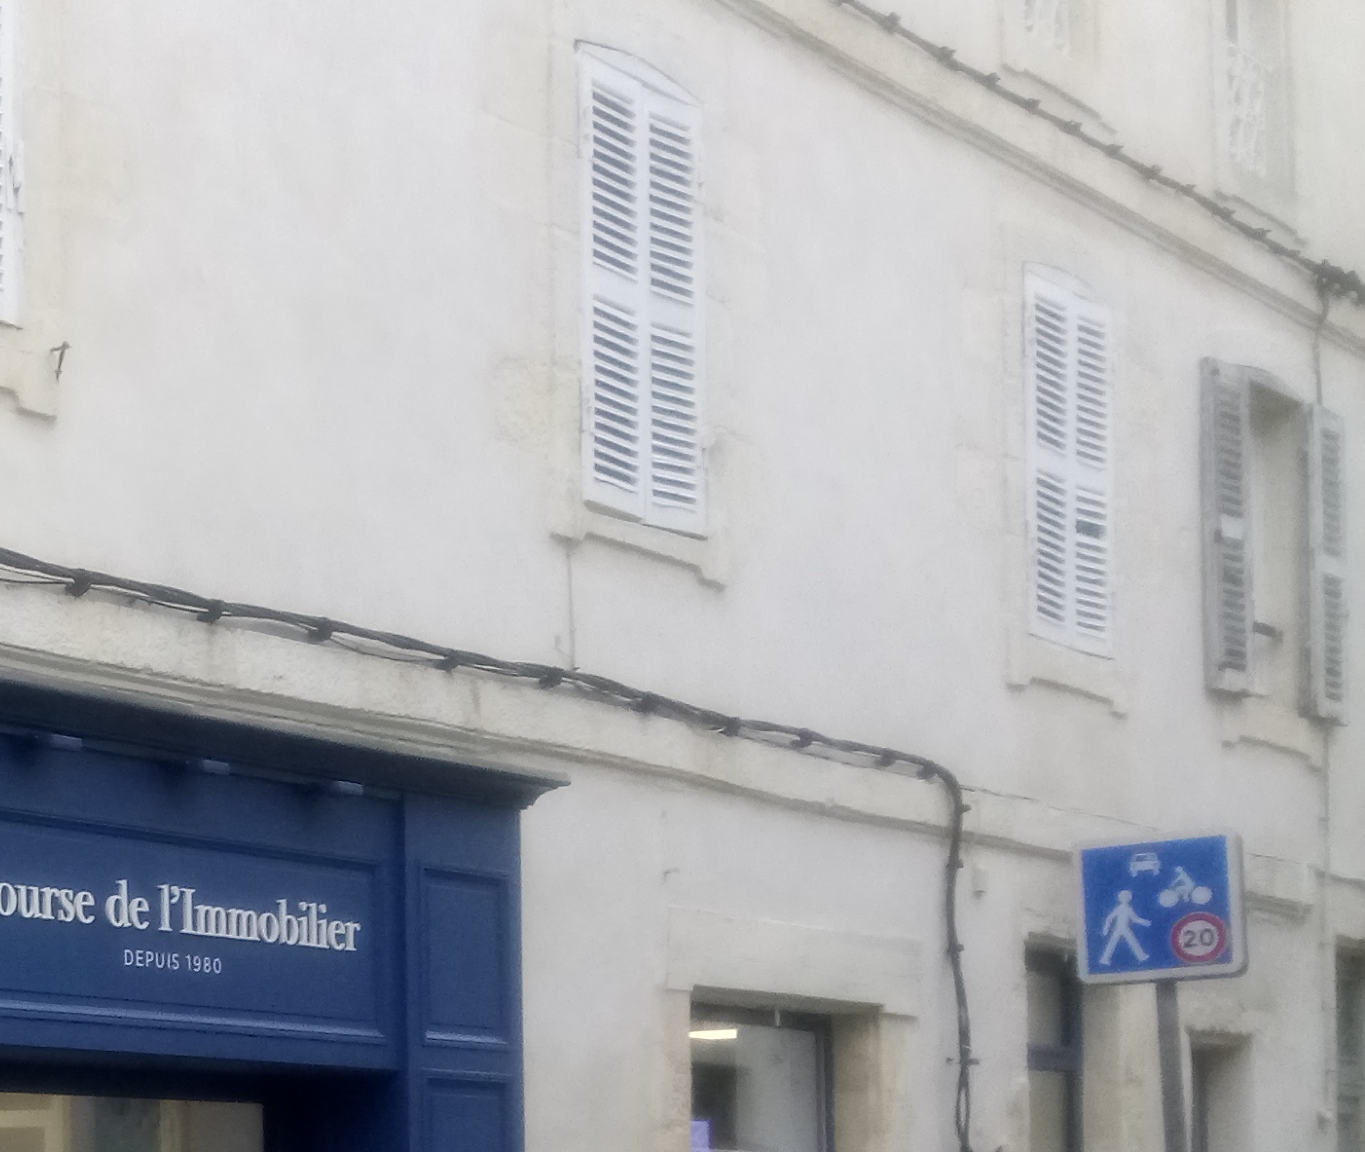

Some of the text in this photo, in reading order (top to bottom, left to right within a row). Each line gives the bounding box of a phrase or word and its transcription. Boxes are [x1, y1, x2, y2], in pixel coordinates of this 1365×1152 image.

[105, 879, 150, 931] de
[1183, 928, 1215, 949] 20
[123, 948, 224, 974] DEPUIS 1980
